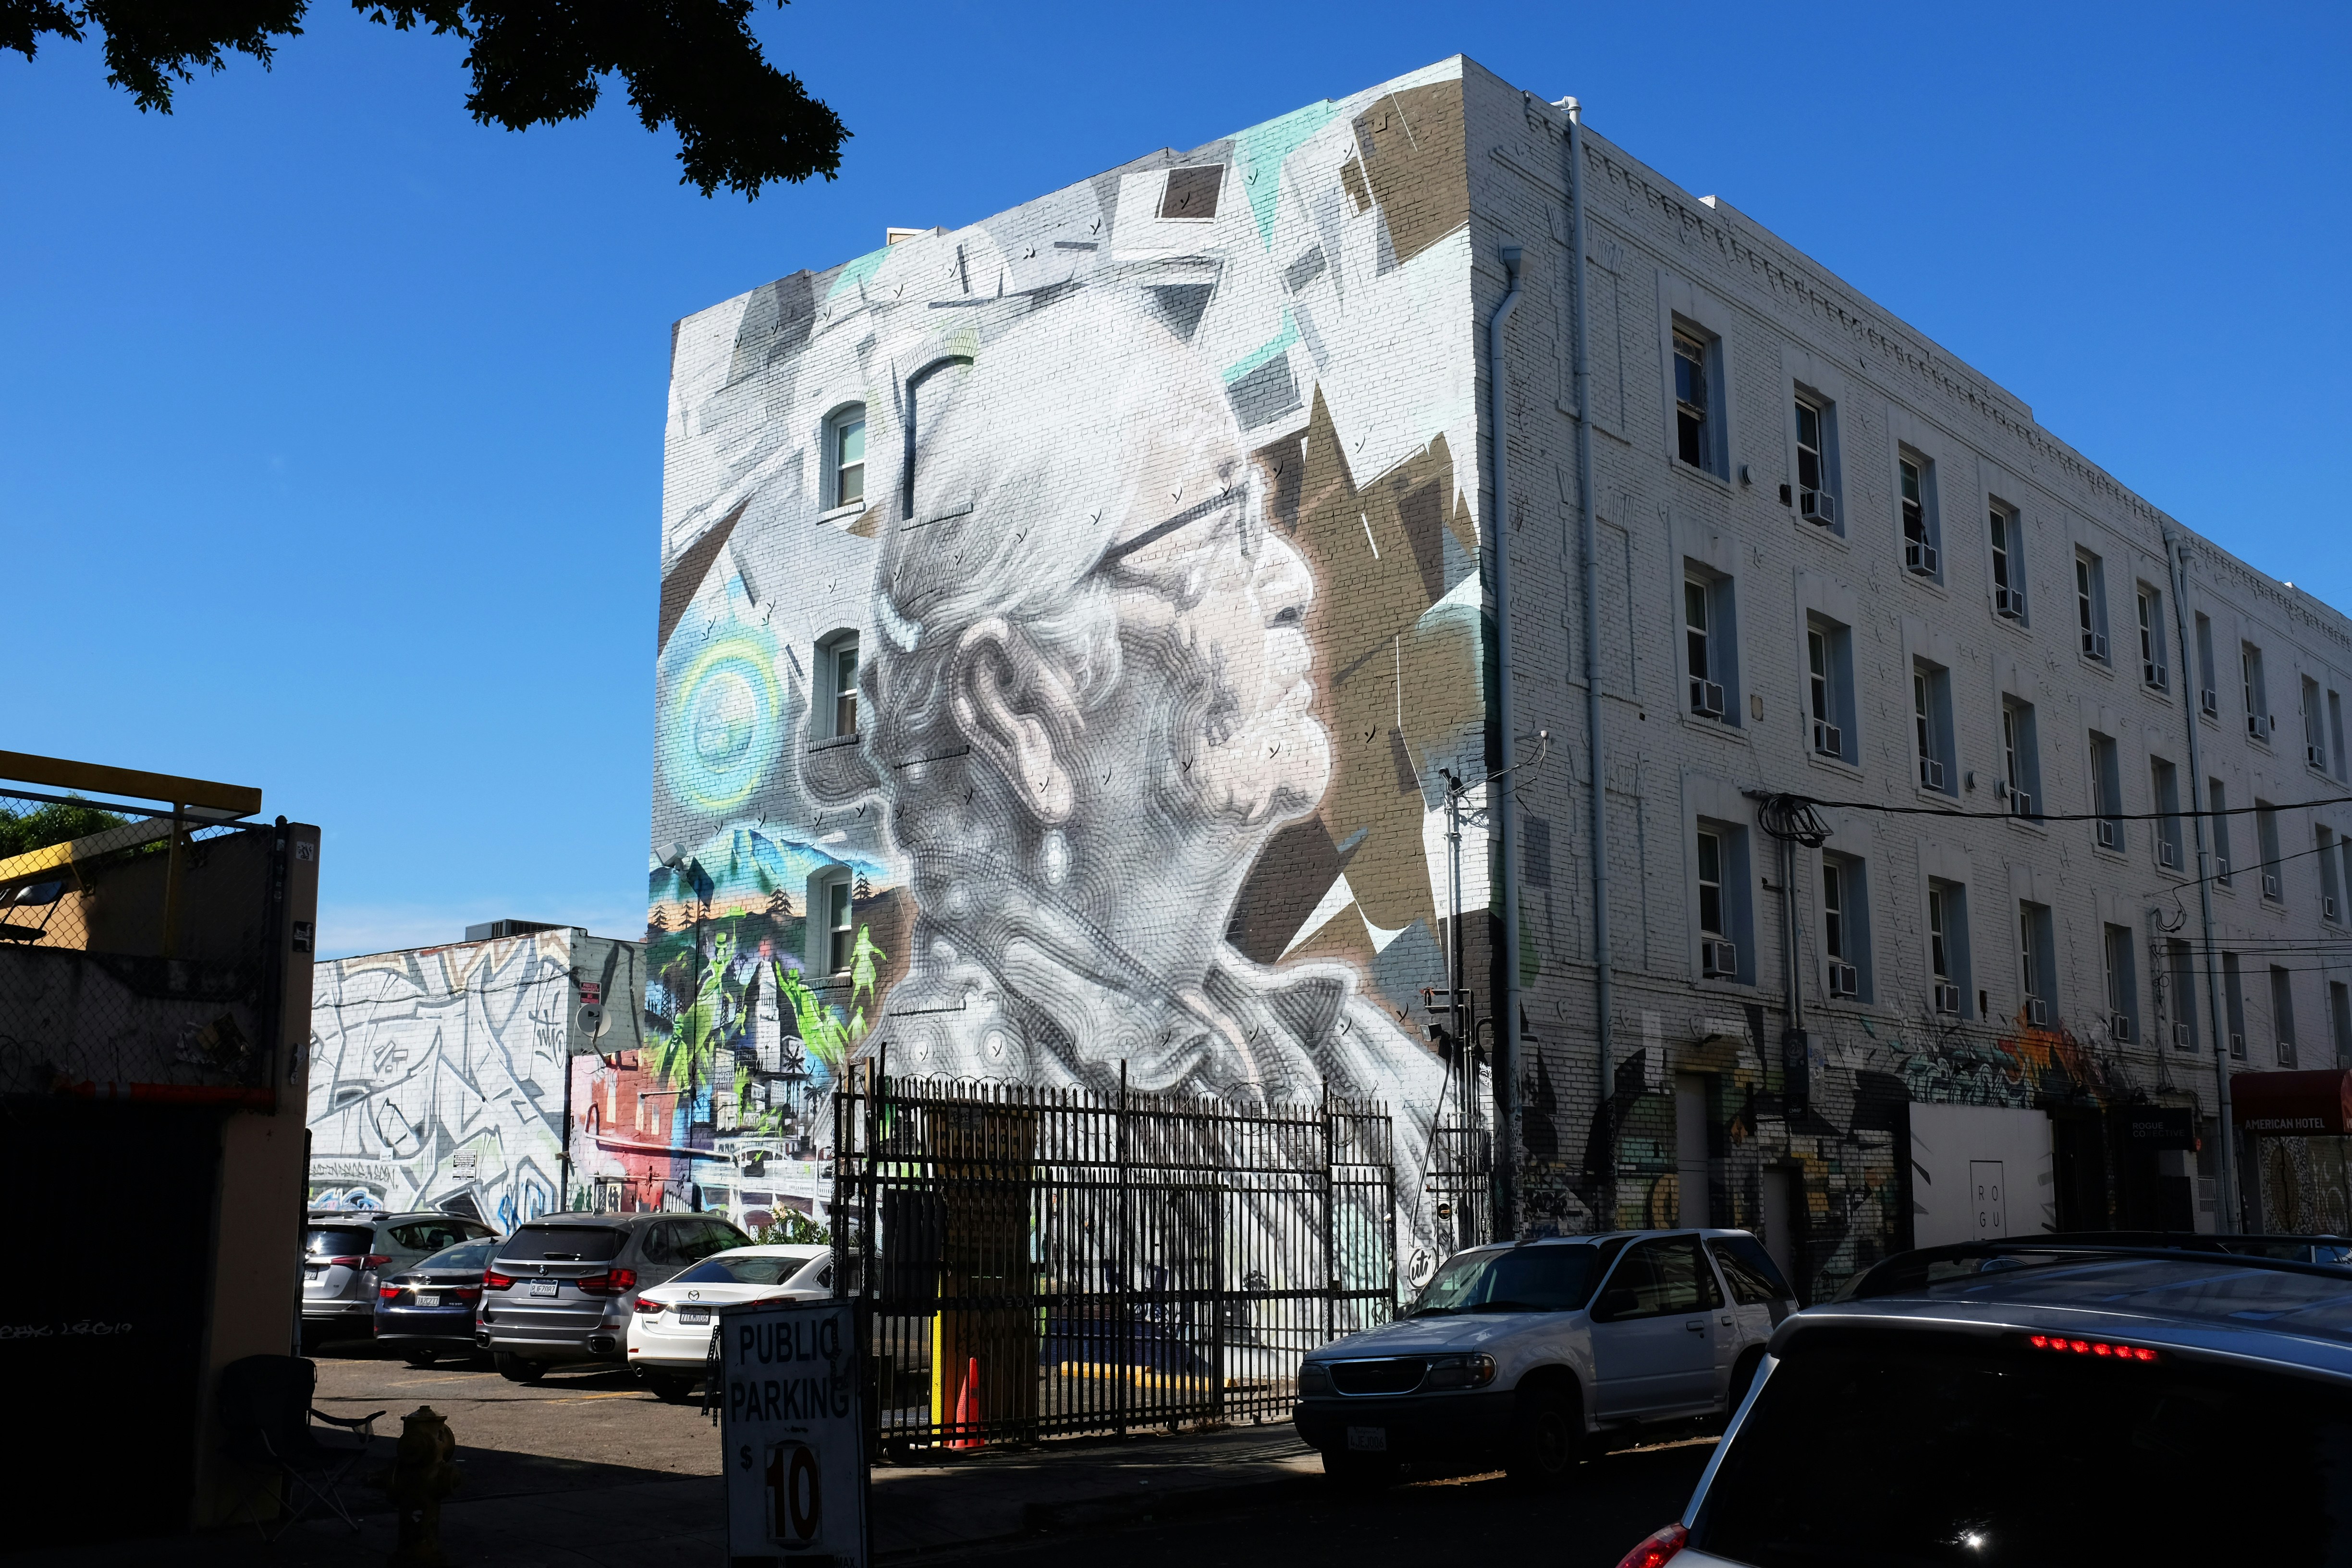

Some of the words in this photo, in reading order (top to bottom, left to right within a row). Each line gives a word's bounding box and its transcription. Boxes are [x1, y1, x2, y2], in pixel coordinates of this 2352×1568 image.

[2245, 1118, 2293, 1129] AMERICAN
[2295, 1117, 2325, 1128] HOTEL
[740, 1318, 838, 1365] PUBLIC
[731, 1377, 849, 1422] PARKING
[1350, 1435, 1384, 1448] 4JEJ006
[767, 1446, 819, 1540] 10
